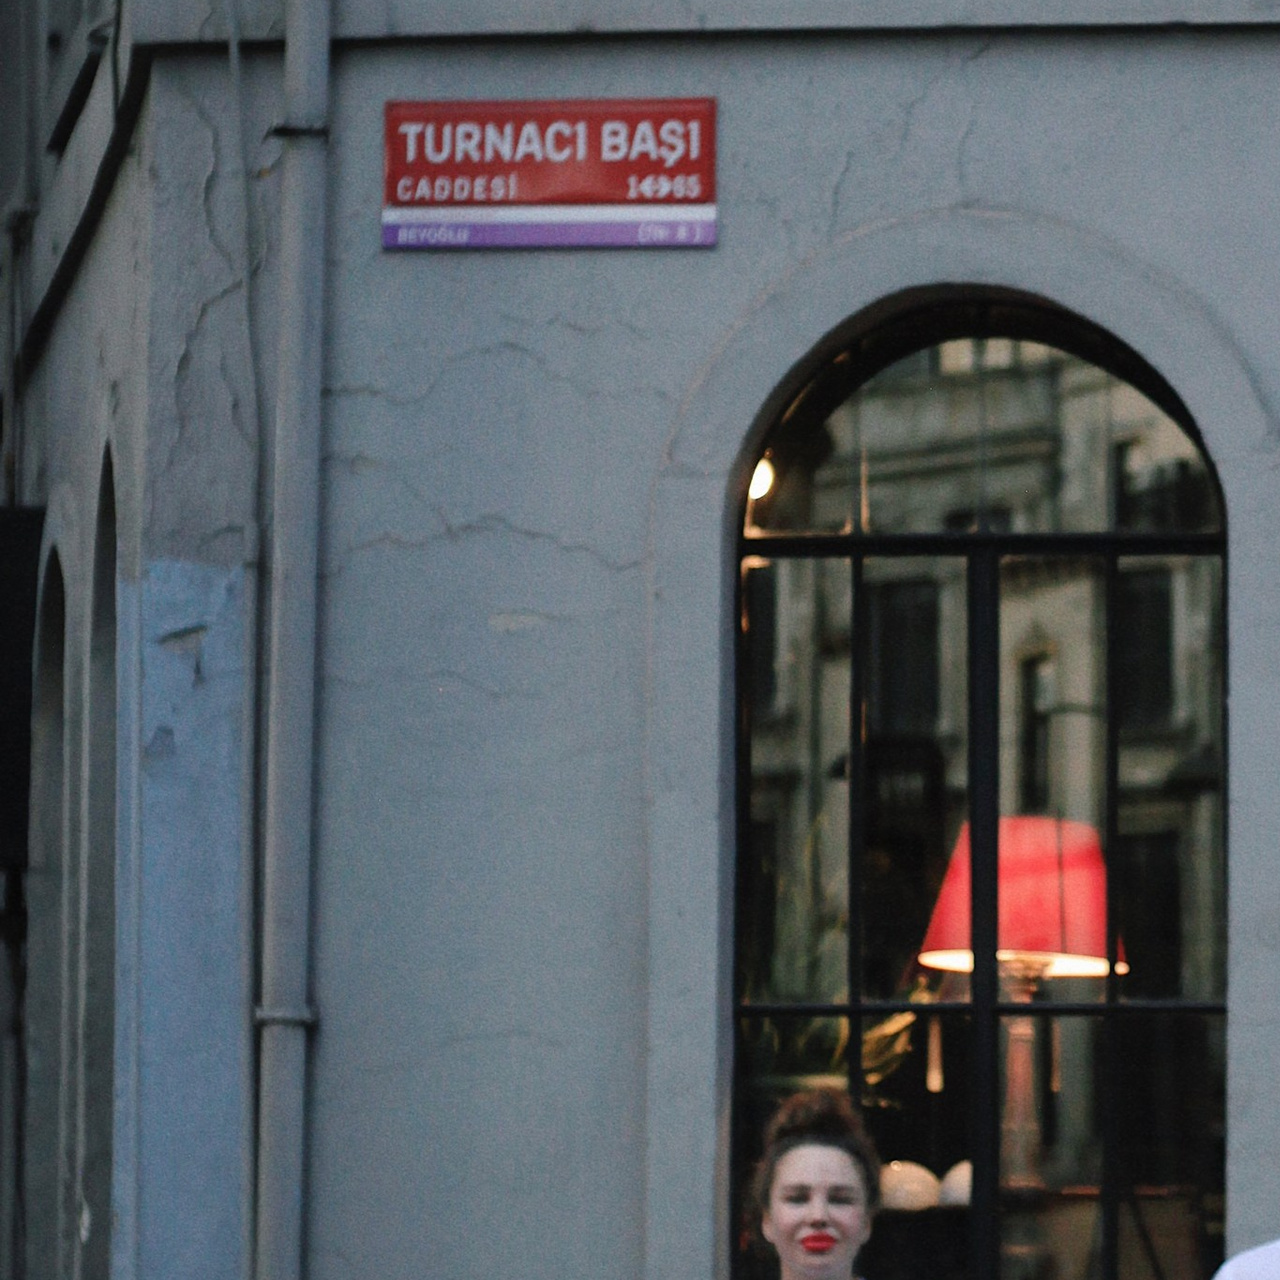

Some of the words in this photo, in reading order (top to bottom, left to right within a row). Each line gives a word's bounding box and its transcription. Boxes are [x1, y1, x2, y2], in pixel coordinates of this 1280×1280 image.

[397, 120, 588, 164] TURNACI
[601, 120, 701, 168] BAŞI
[396, 170, 519, 201] CADDESİ
